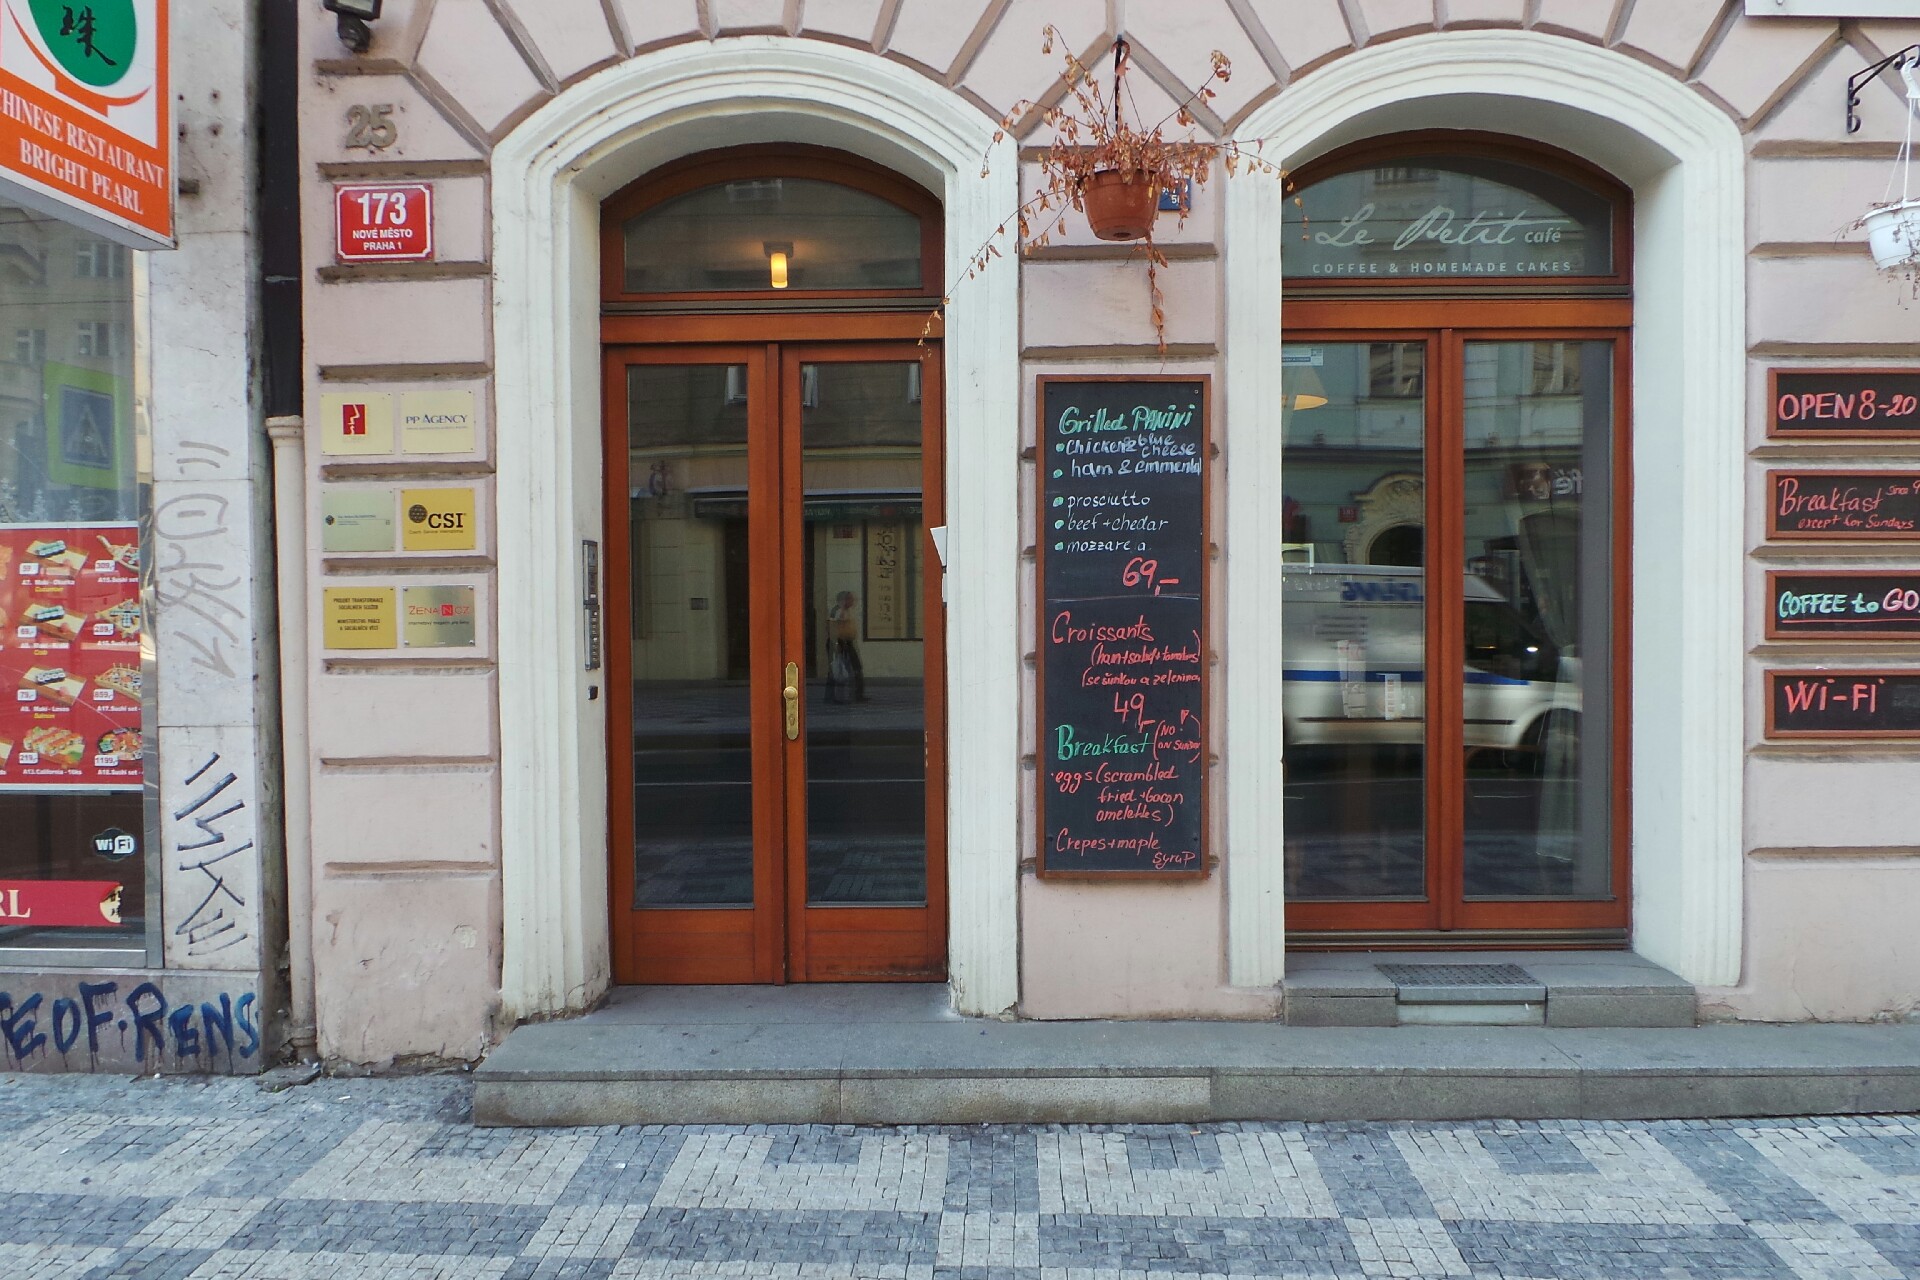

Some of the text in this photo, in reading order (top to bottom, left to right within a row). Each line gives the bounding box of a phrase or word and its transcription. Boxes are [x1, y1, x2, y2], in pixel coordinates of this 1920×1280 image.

[346, 104, 398, 148] 25
[66, 121, 164, 189] RESTAURANT
[20, 137, 144, 215] BRIGHT PEARL
[357, 192, 407, 225] 173
[352, 227, 413, 239] NOVÉ MĚSTO
[1314, 202, 1571, 251] Le Petit café
[363, 241, 402, 251] PRAHA 1
[1312, 261, 1572, 274] COFFEE & HOMEMADE CAKES
[1778, 389, 1918, 421] OPEN 8-20
[405, 415, 420, 424] PP
[1058, 406, 1128, 435] Grilled
[1138, 432, 1175, 447] blue
[1141, 443, 1197, 459] cheese
[1071, 458, 1114, 478] ham
[1117, 459, 1132, 475] &
[1067, 490, 1151, 518] prosciutto
[1778, 477, 1884, 516] Breakfast
[428, 513, 464, 529] CSI
[1067, 512, 1103, 531] beef
[1798, 513, 1914, 530] except for Sundays
[1779, 590, 1848, 618] COFFEE
[1851, 592, 1879, 613] to
[1052, 611, 1154, 645] Croissants
[1055, 723, 1154, 761] Breakfast
[1055, 771, 1093, 793] eggs
[1097, 785, 1137, 804] fried
